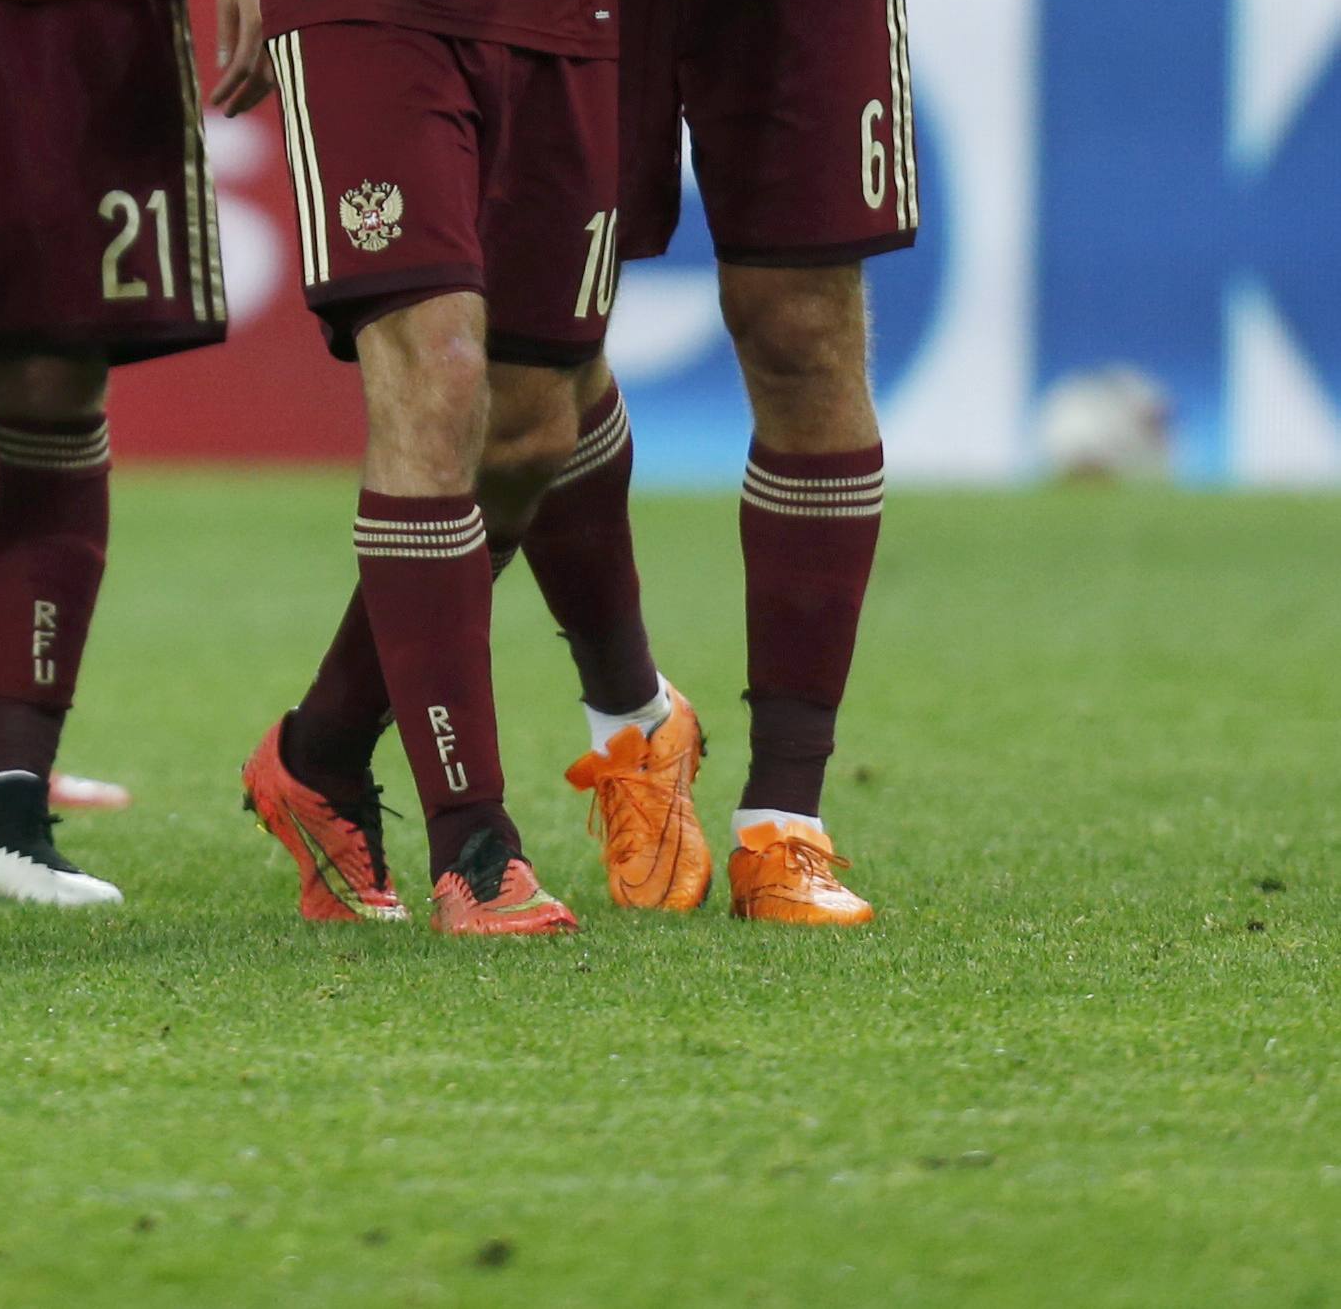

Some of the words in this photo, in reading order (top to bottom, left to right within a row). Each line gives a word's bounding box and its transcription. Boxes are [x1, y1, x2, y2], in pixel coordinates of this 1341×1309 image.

[861, 99, 885, 209] 6
[98, 189, 175, 299] 21
[574, 207, 617, 318] 10
[33, 600, 56, 685] RFU
[427, 704, 469, 792] RFU
